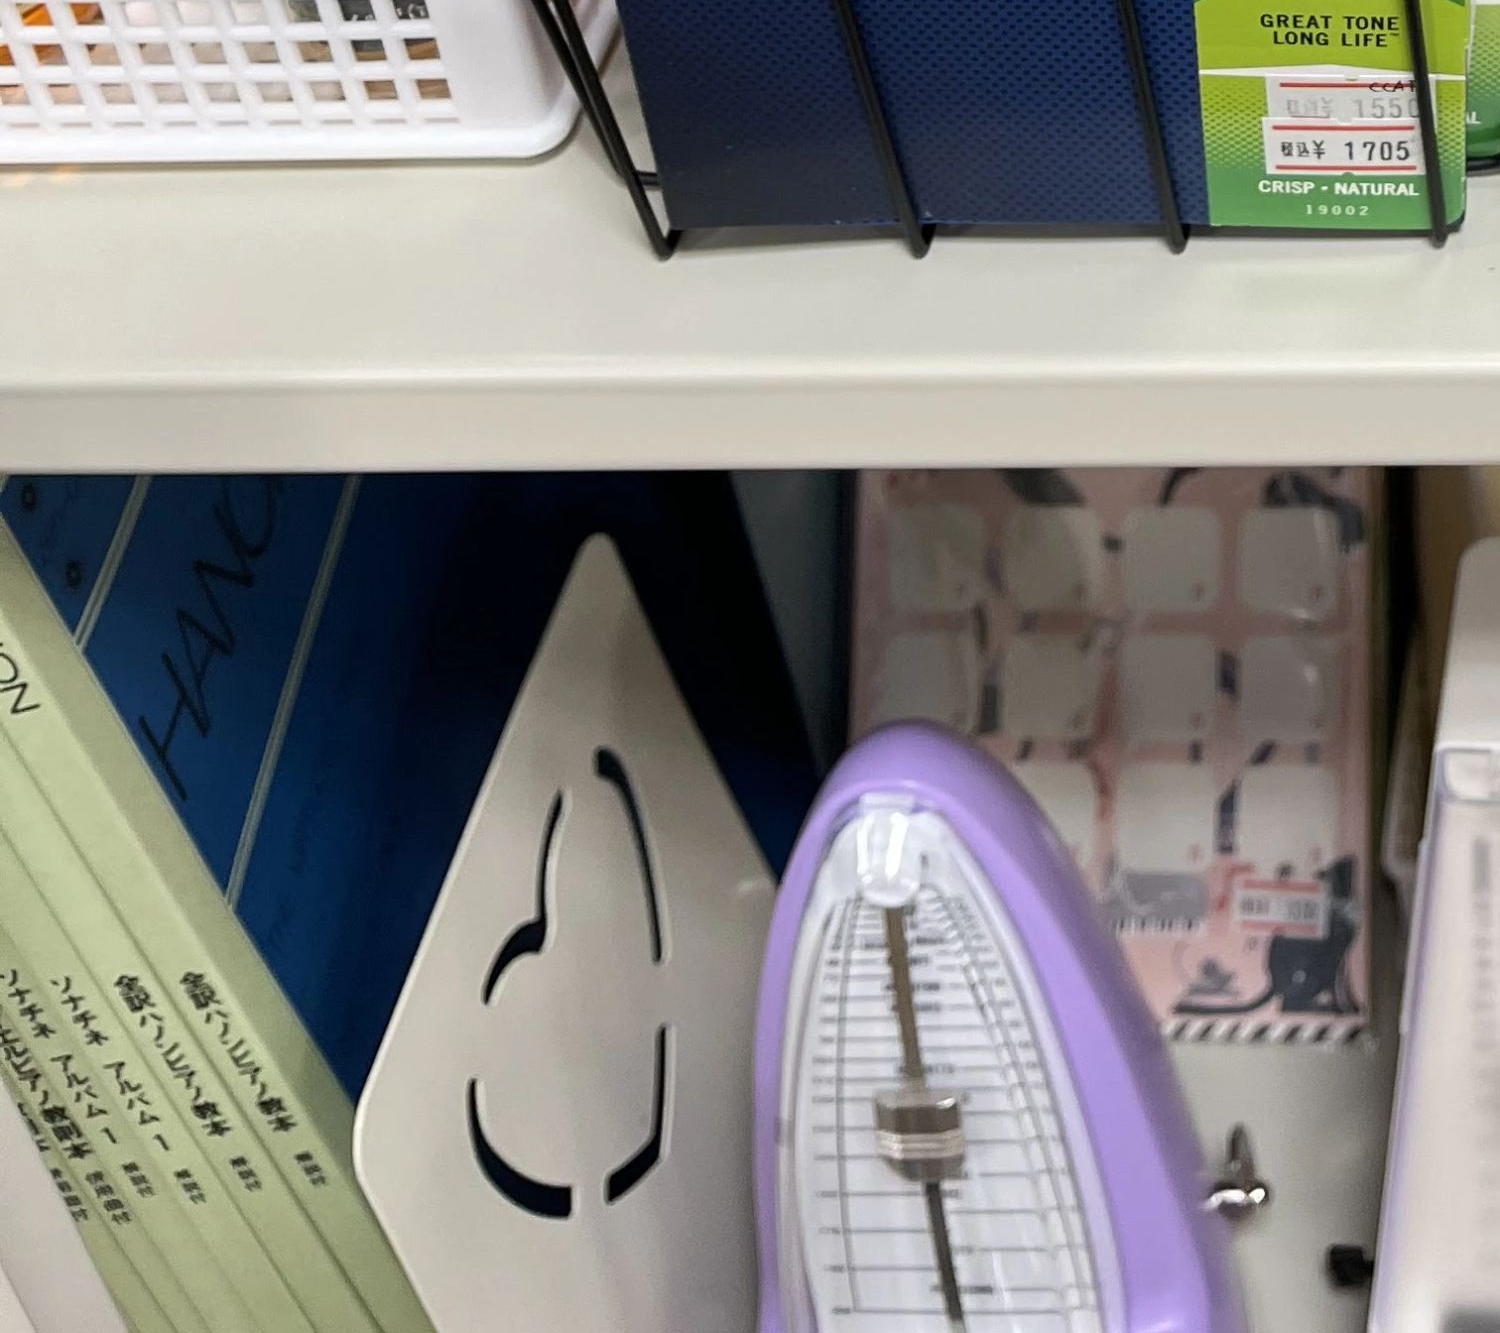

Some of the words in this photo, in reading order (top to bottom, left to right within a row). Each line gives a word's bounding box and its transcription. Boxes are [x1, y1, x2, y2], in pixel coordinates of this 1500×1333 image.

[1260, 13, 1333, 29] GREAT
[1343, 15, 1400, 31] TONE
[1272, 30, 1330, 46] LONG
[1343, 140, 1410, 162] 1705
[1258, 179, 1316, 194] CRISP
[1334, 182, 1420, 196] NATURAL
[1305, 204, 1369, 217] 19002
